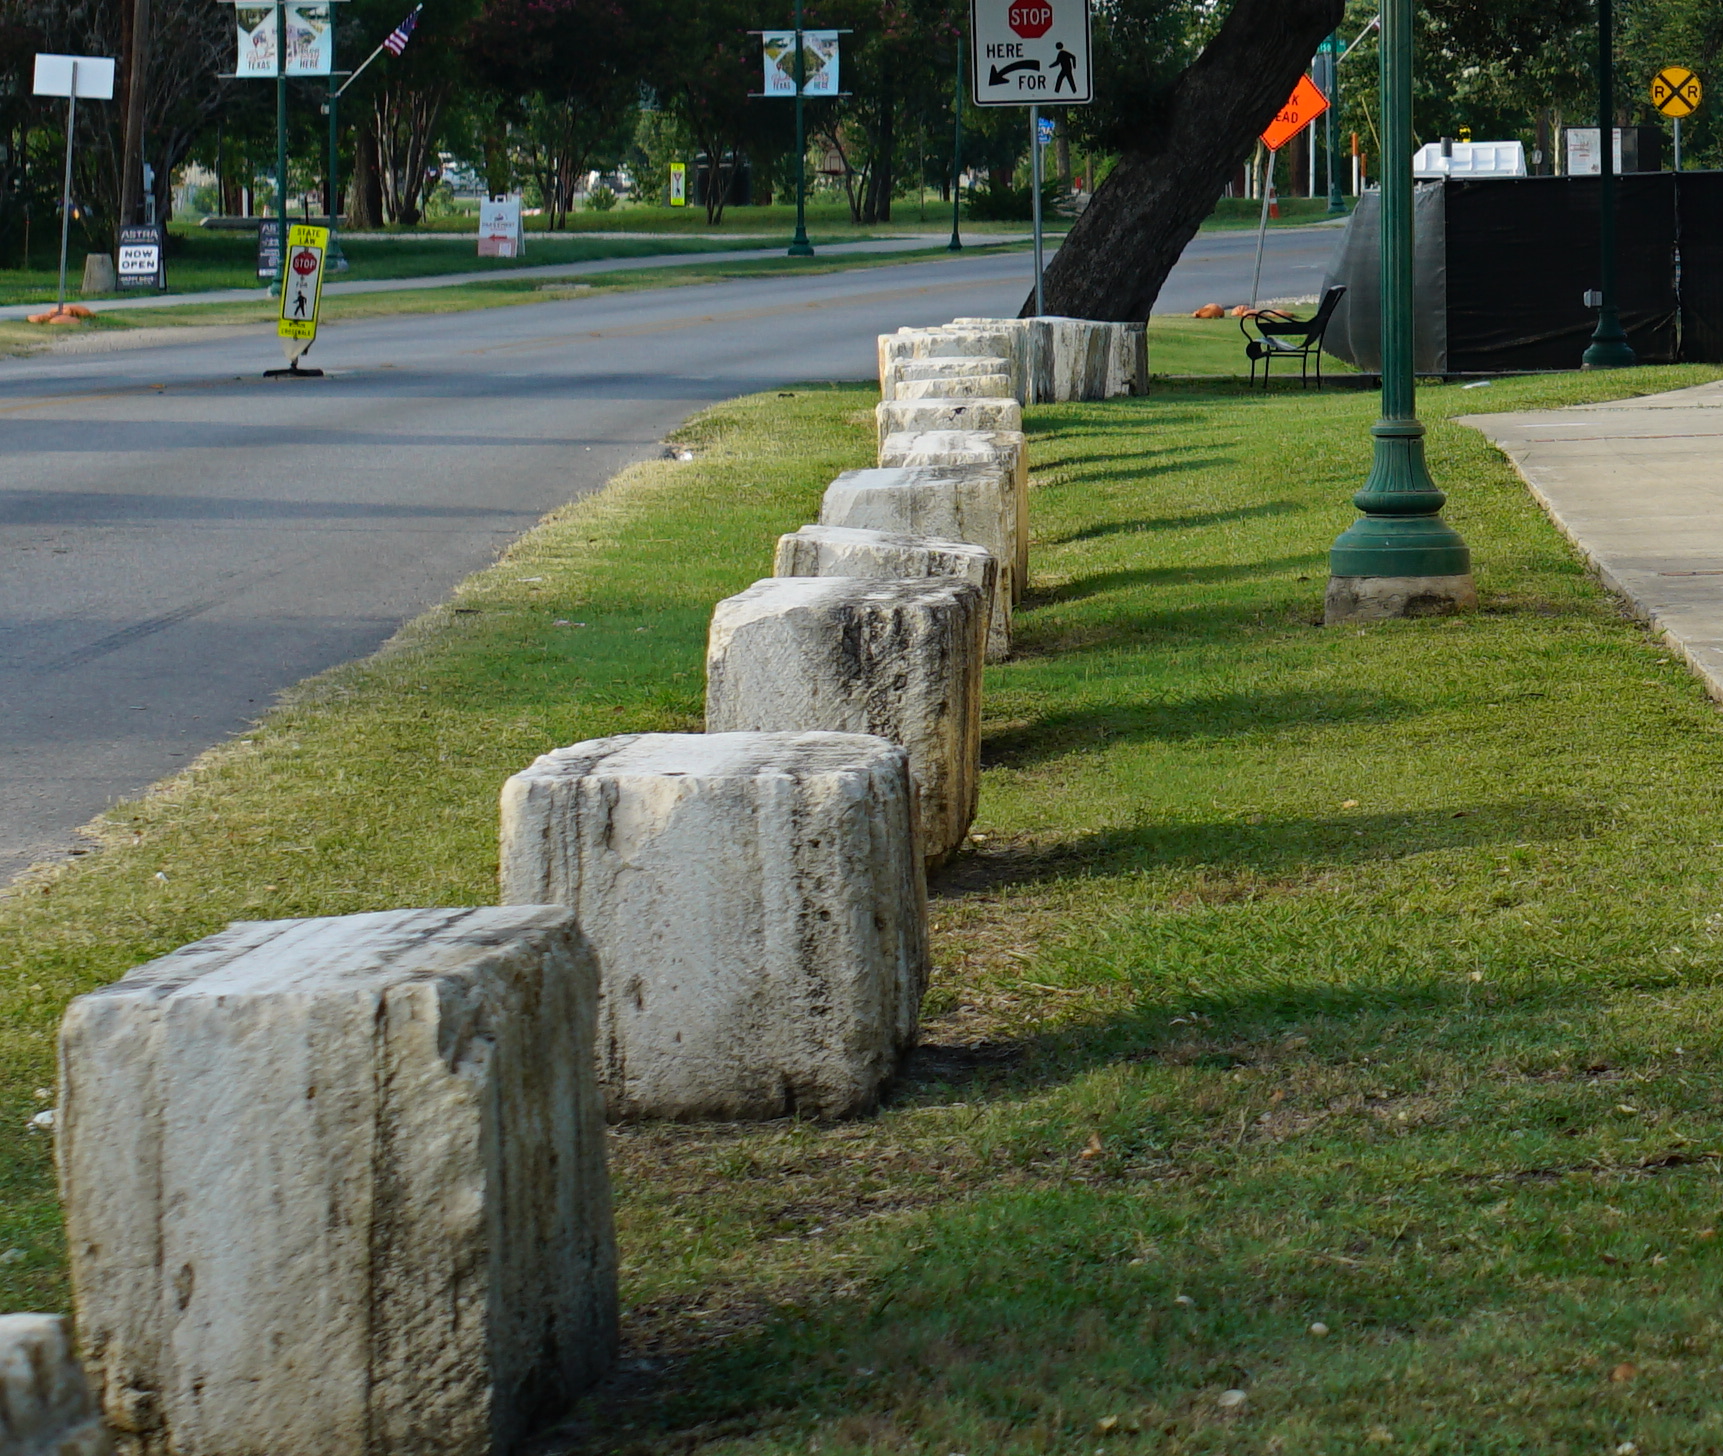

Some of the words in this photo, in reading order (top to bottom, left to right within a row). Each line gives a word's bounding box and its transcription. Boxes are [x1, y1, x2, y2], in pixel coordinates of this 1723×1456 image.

[1011, 8, 1051, 26] STOP
[986, 43, 1024, 59] HERE
[1018, 75, 1046, 90] FOR
[1654, 85, 1665, 98] R
[1687, 85, 1698, 98] R
[121, 229, 159, 241] ASTRA
[297, 227, 321, 238] STATE
[299, 237, 316, 245] LAW
[124, 249, 153, 258] NOW
[121, 260, 155, 269] OPEN
[294, 257, 316, 270] STOP
